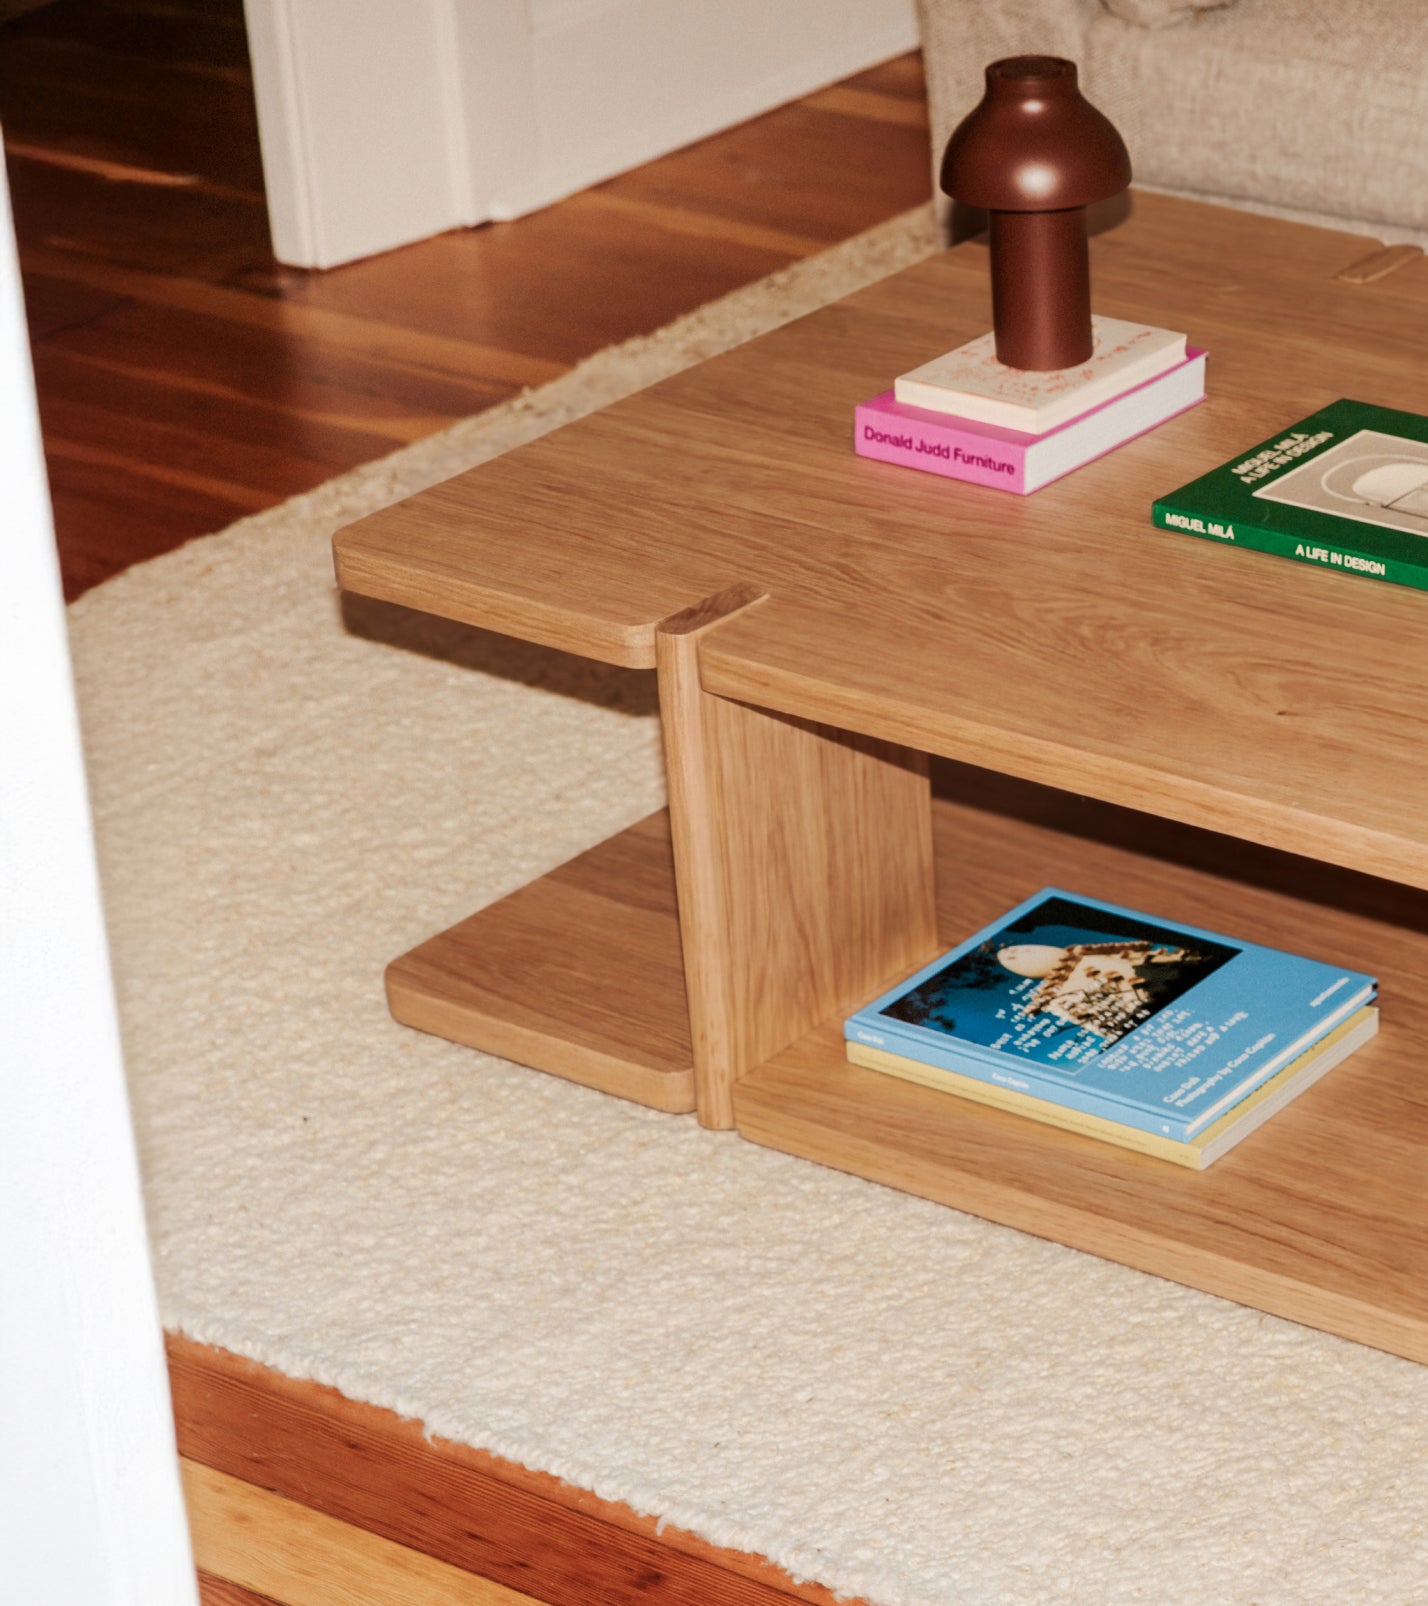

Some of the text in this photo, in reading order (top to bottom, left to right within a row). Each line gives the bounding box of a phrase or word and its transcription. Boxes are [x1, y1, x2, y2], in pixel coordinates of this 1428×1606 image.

[864, 425, 1016, 476] Donald Judd Furniture
[1232, 451, 1281, 474] MIGUEL
[1249, 462, 1279, 477] LIFE
[1286, 432, 1332, 456] DESIGN
[1165, 512, 1235, 540] MIGUEL MILÁ
[1295, 544, 1386, 577] A LIFE IN DESIGN
